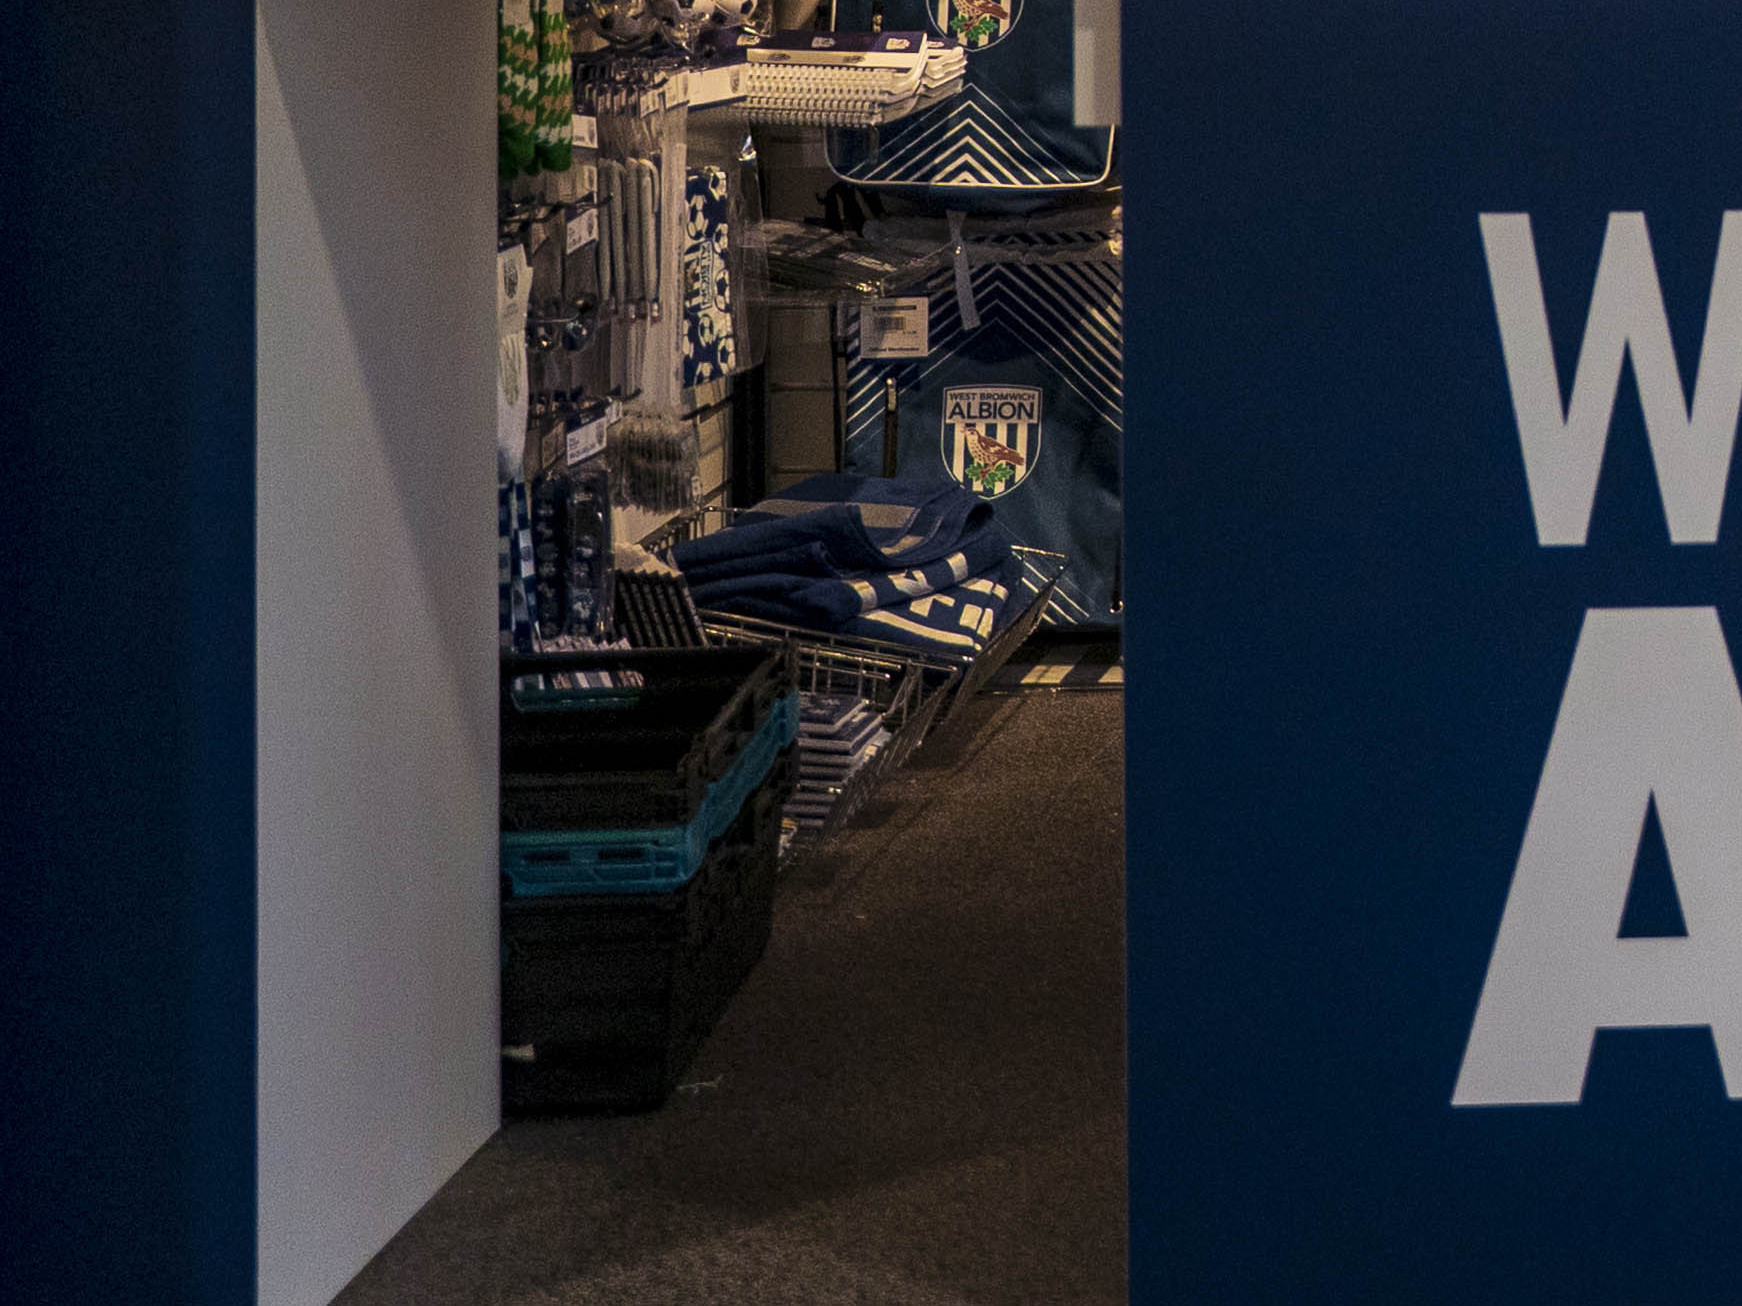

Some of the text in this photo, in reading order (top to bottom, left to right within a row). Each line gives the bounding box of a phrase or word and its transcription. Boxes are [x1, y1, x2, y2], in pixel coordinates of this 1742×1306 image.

[949, 392, 1035, 401] WEST BROMWICH
[949, 401, 1035, 420] ALBION
